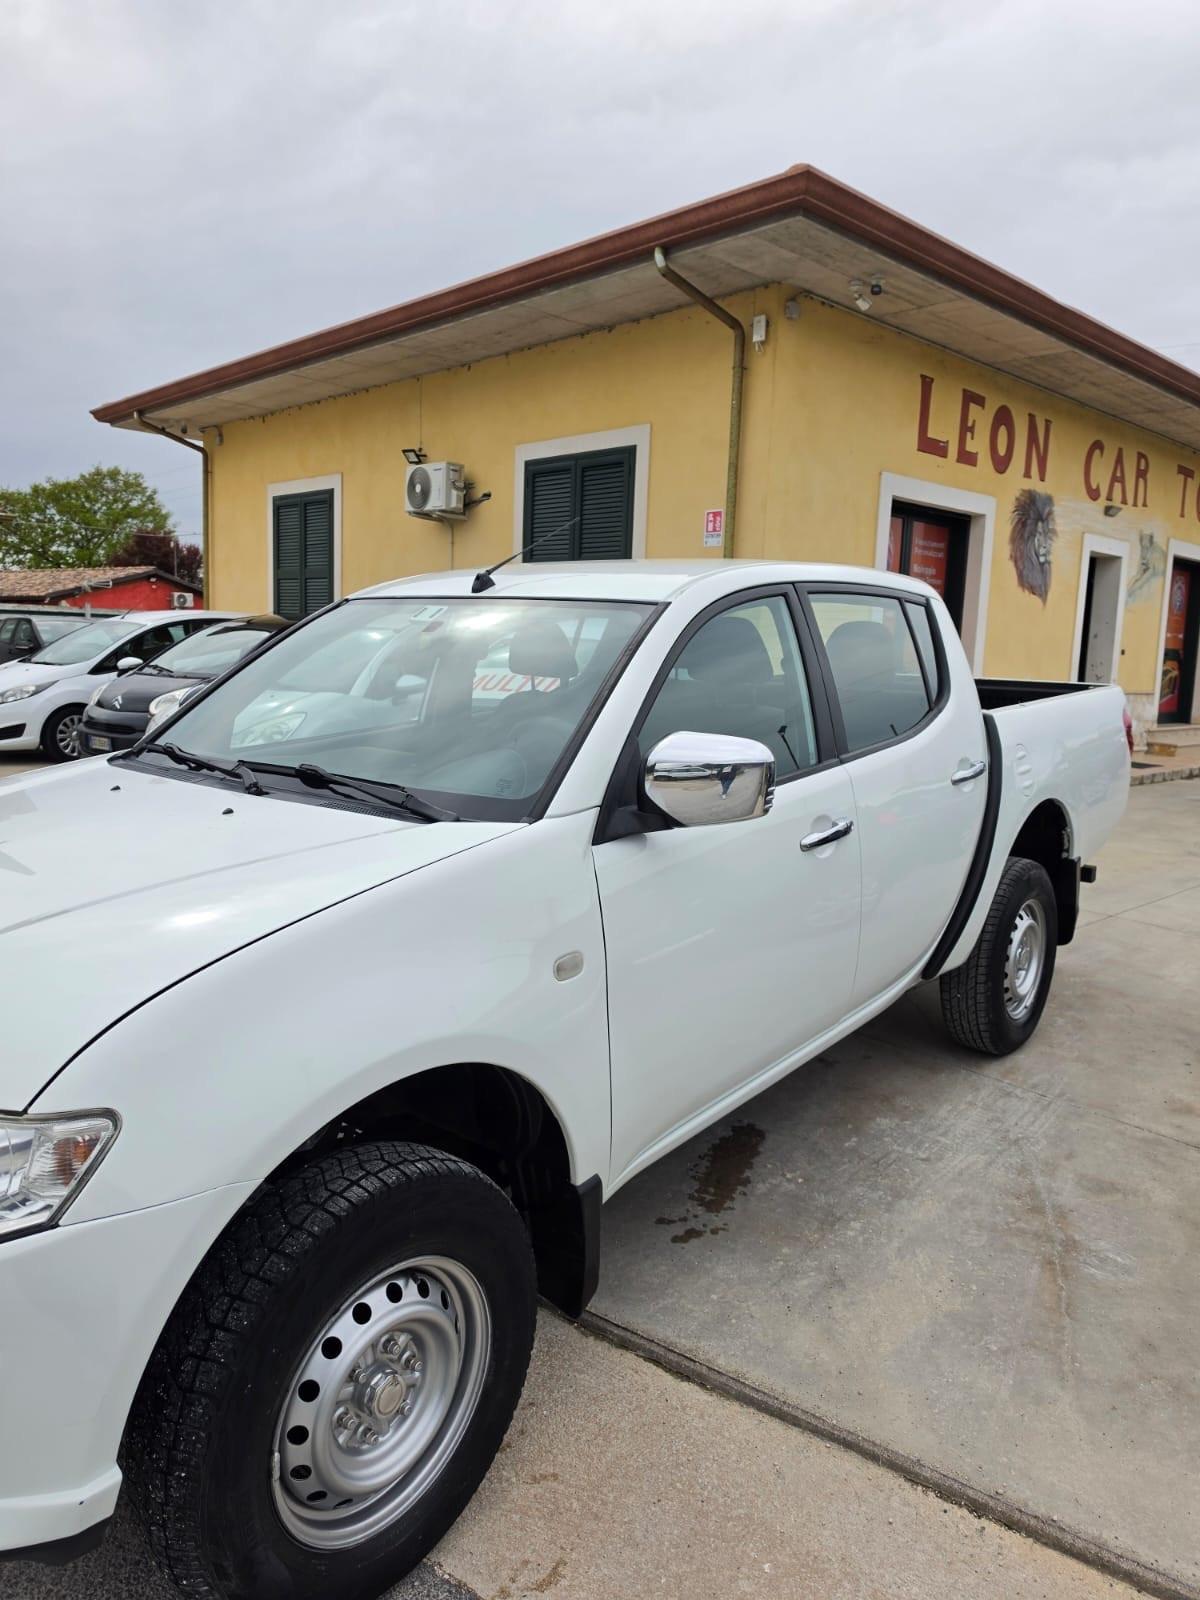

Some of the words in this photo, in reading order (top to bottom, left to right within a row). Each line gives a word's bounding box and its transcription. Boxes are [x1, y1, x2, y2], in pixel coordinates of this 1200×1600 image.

[917, 374, 1052, 482] LEON
[1084, 440, 1150, 508] CAR
[1177, 464, 1200, 522] T
